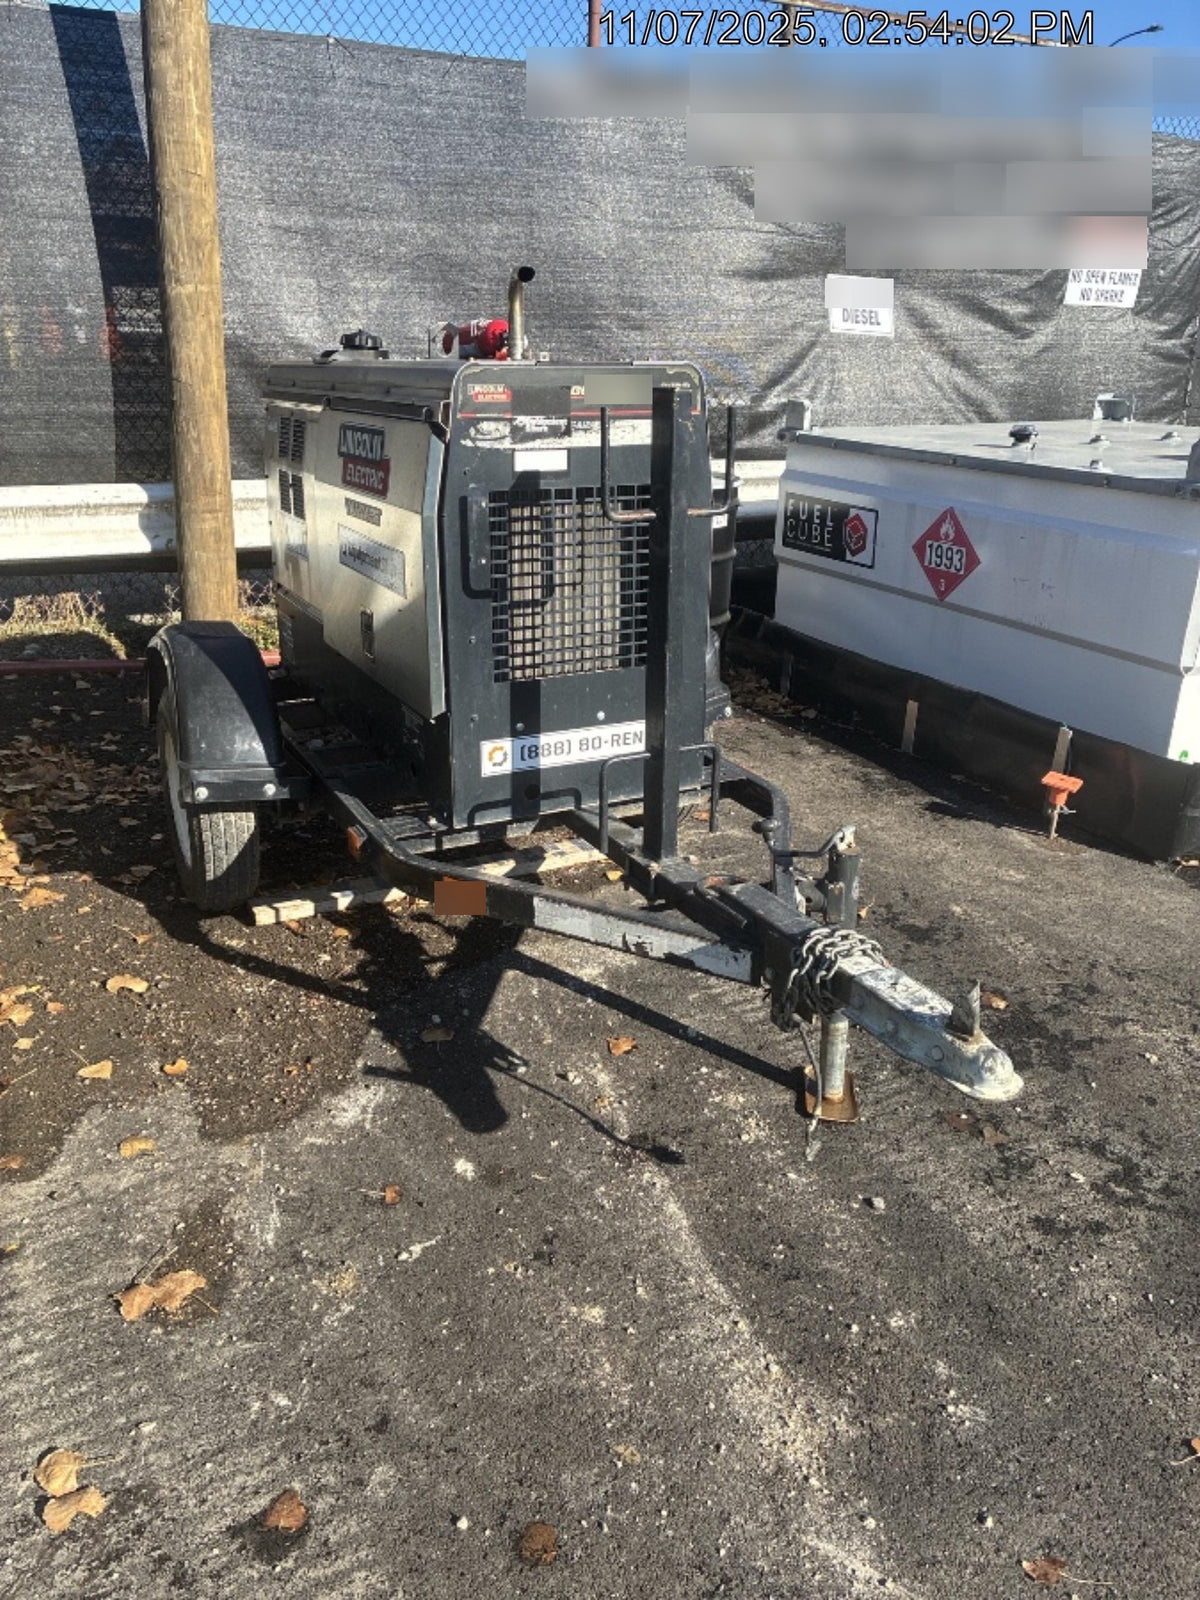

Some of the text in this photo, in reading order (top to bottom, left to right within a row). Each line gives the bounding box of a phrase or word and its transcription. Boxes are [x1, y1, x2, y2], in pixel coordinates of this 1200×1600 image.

[842, 307, 881, 326] DIESEL
[340, 427, 383, 461] LINCOLN
[346, 463, 385, 490] ELECTRIC
[786, 498, 834, 527] FUEL
[786, 518, 833, 547] CUBE
[926, 542, 965, 574] 1993
[939, 578, 946, 591] 3
[520, 730, 645, 762] (888) 80-REN
